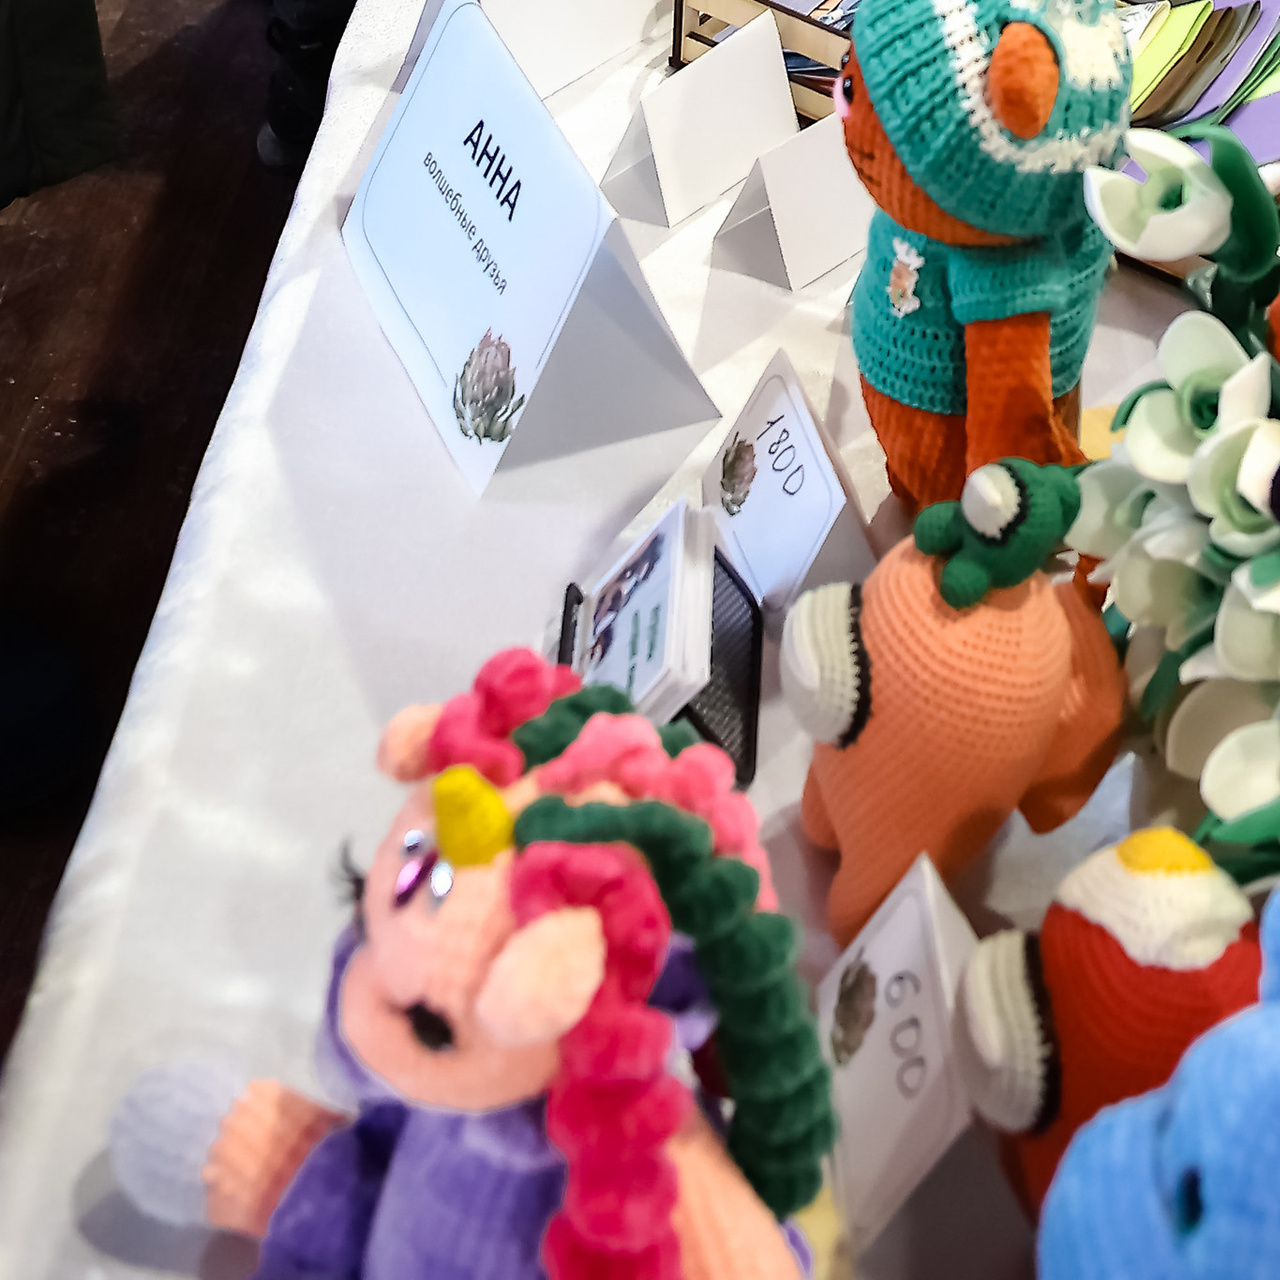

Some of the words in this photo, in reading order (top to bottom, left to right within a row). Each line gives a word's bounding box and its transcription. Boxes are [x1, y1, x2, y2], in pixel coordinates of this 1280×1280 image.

[422, 151, 477, 242] волшебные
[471, 237, 509, 297] друзья
[463, 118, 525, 222] АННА
[756, 413, 806, 497] 1800
[884, 969, 928, 1100] 600
